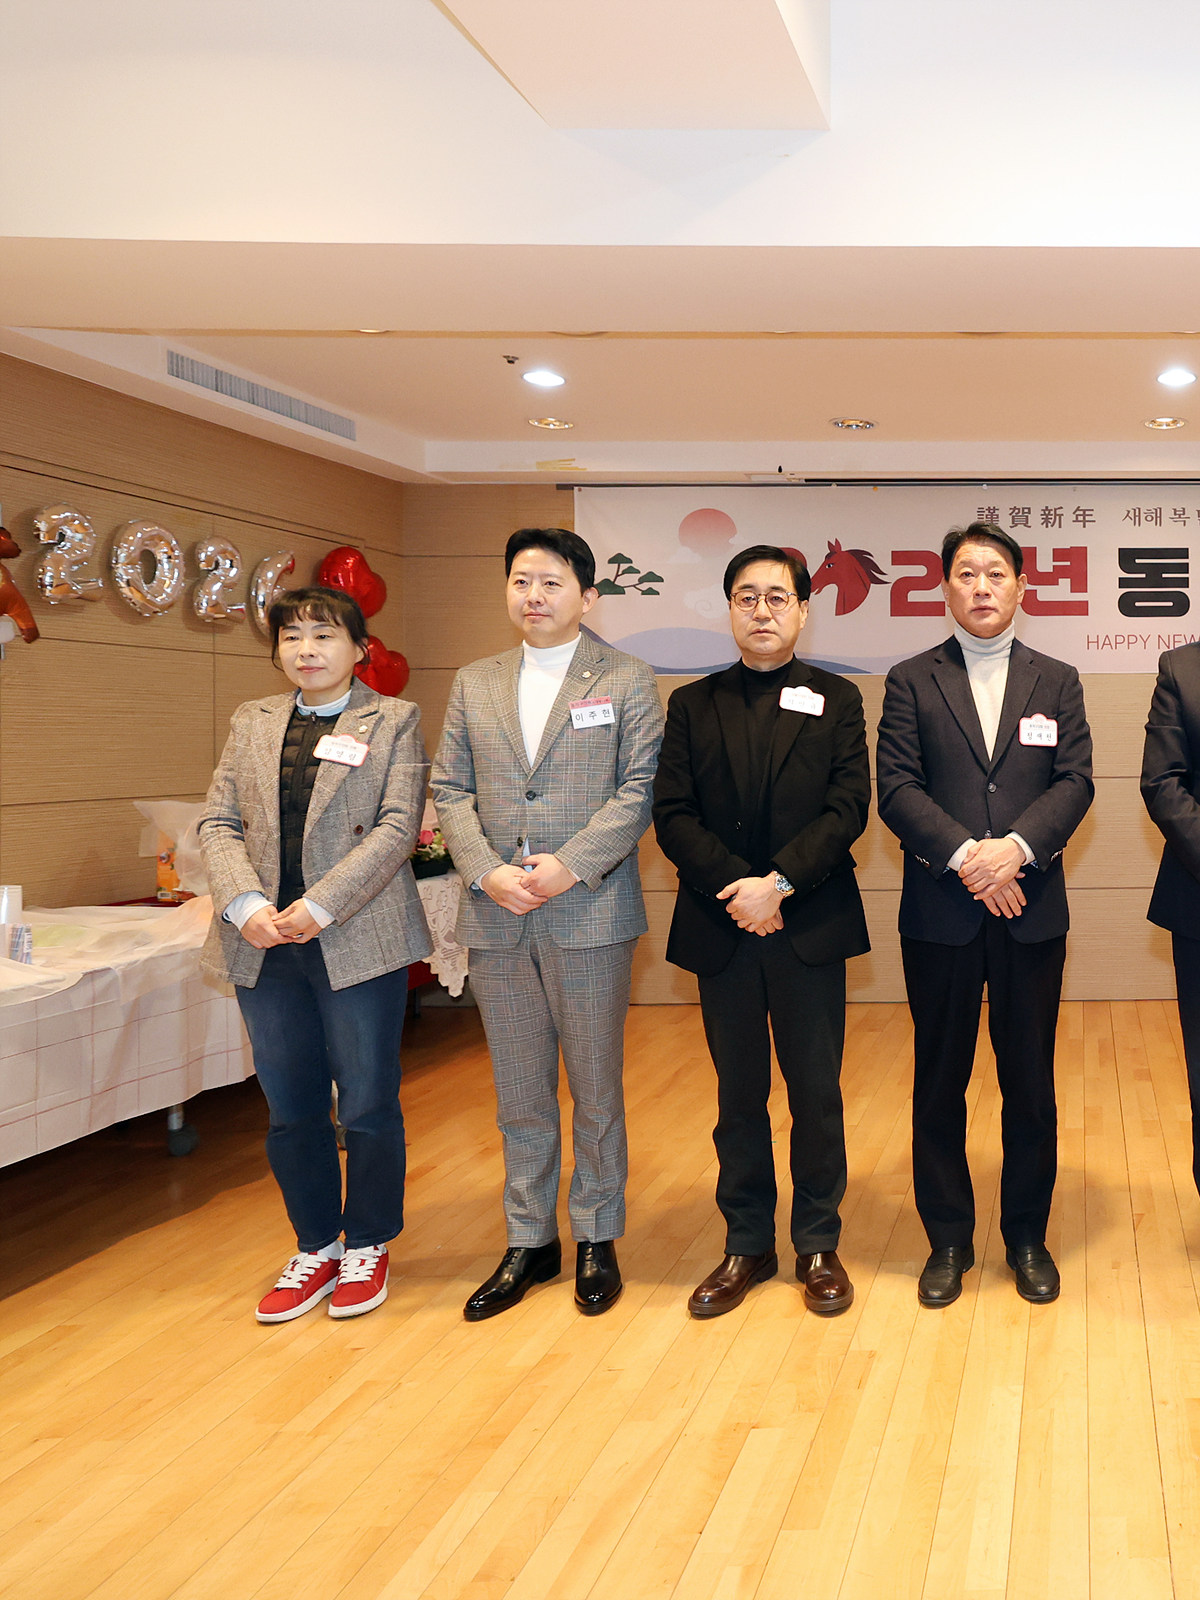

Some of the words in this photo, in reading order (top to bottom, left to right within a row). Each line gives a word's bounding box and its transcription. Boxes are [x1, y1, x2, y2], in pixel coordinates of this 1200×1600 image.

[1121, 506, 1163, 528] 새해
[1168, 507, 1191, 527] 복
[1086, 633, 1151, 651] HAPPY
